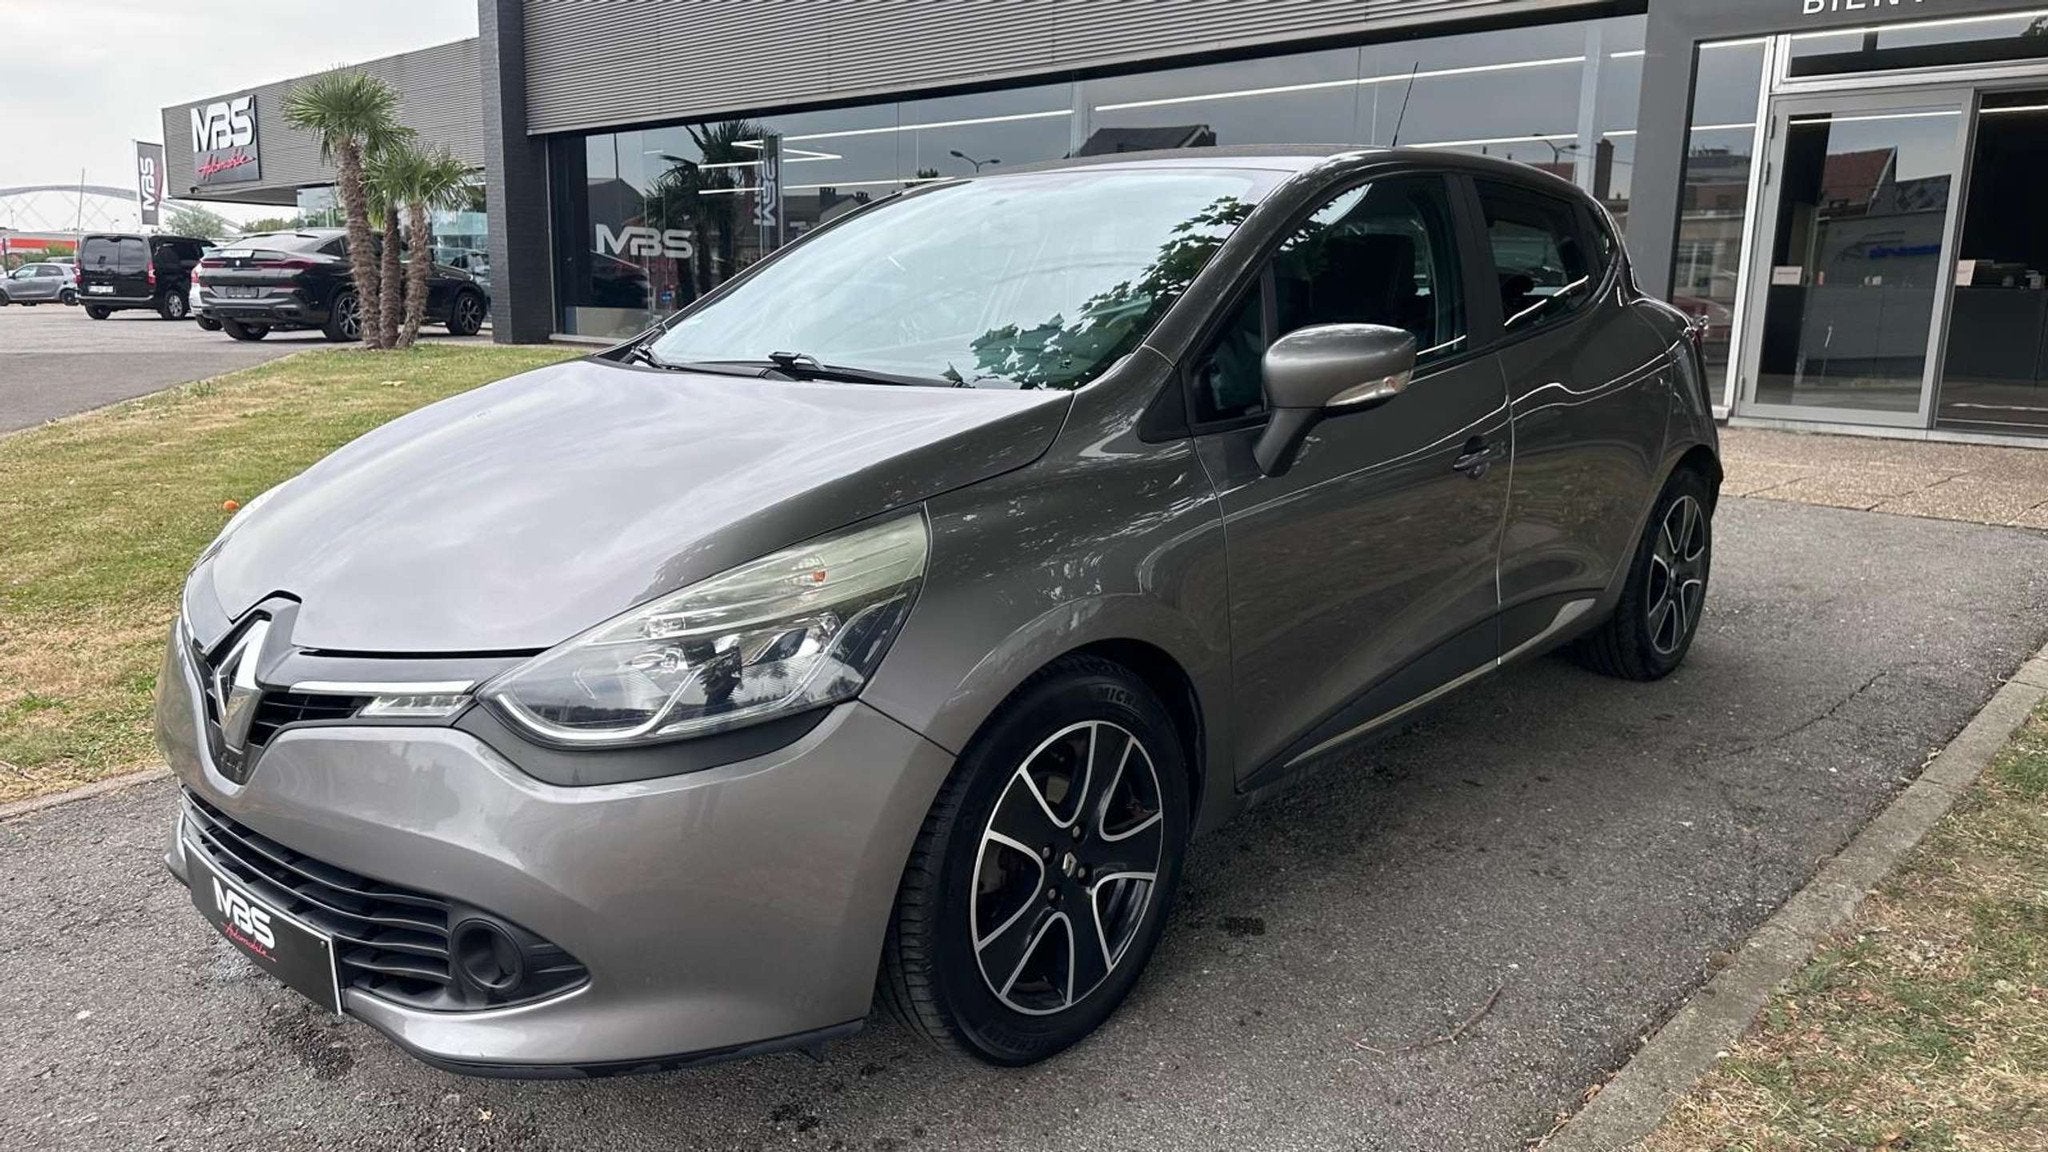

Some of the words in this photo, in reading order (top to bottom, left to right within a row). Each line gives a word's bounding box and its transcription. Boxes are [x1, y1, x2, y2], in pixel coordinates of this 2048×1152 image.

[190, 95, 253, 152] MBS
[140, 156, 155, 211] MBS
[595, 223, 694, 259] MBS
[212, 875, 275, 949] MBS
